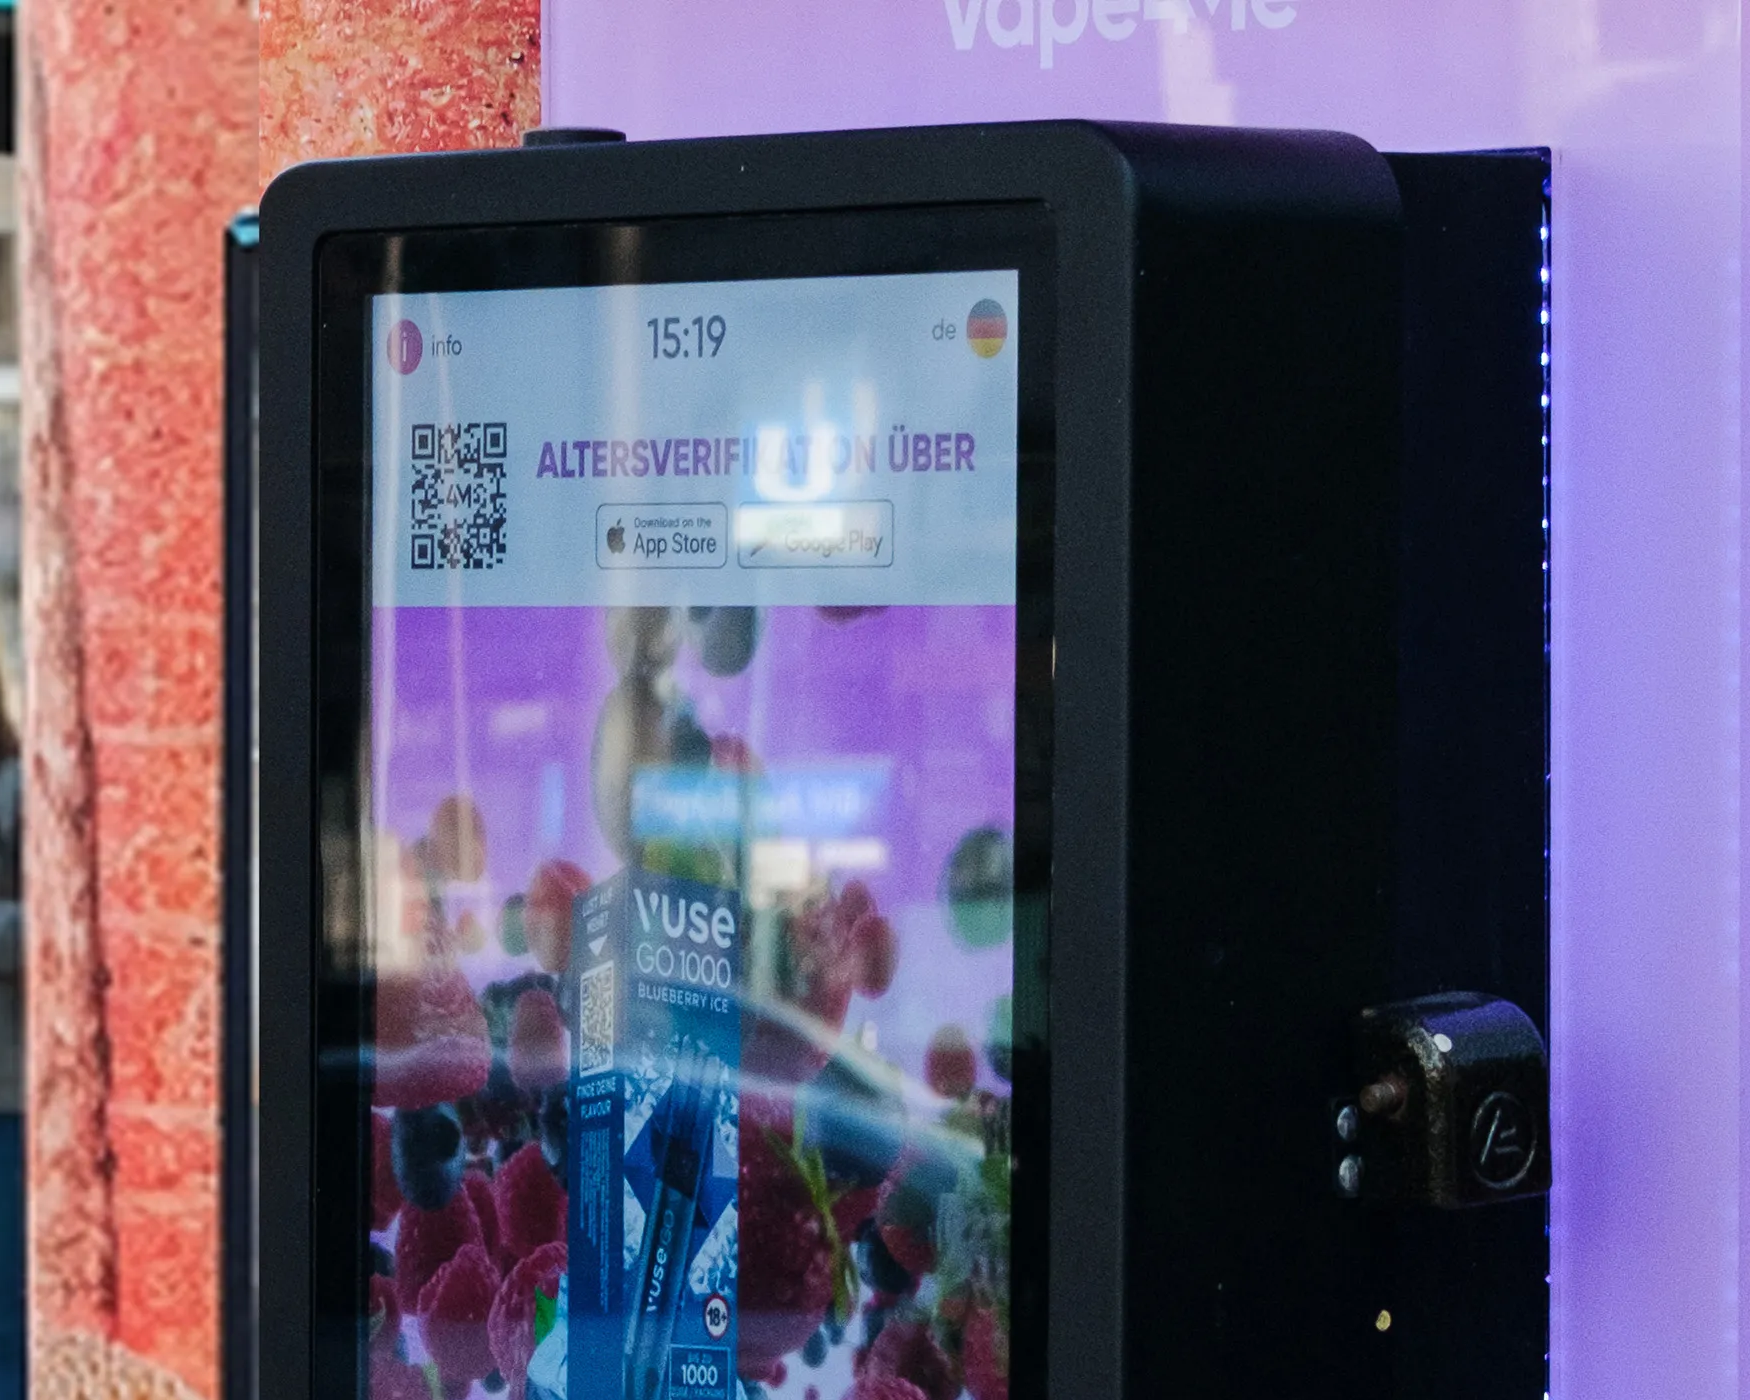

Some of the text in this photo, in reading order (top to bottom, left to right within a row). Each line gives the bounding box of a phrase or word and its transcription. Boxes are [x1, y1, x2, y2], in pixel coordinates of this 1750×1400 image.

[647, 315, 727, 359] 15:19
[932, 319, 957, 343] de
[431, 334, 462, 356] info
[888, 424, 976, 473] ÜBER
[634, 516, 712, 529] Download on the
[633, 532, 717, 558] App Store
[849, 530, 883, 557] Play
[636, 943, 731, 989] GO 1000
[638, 981, 730, 1013] BLUEBERRY ICE
[707, 1306, 727, 1327] 18+
[681, 1363, 718, 1387] 1000
